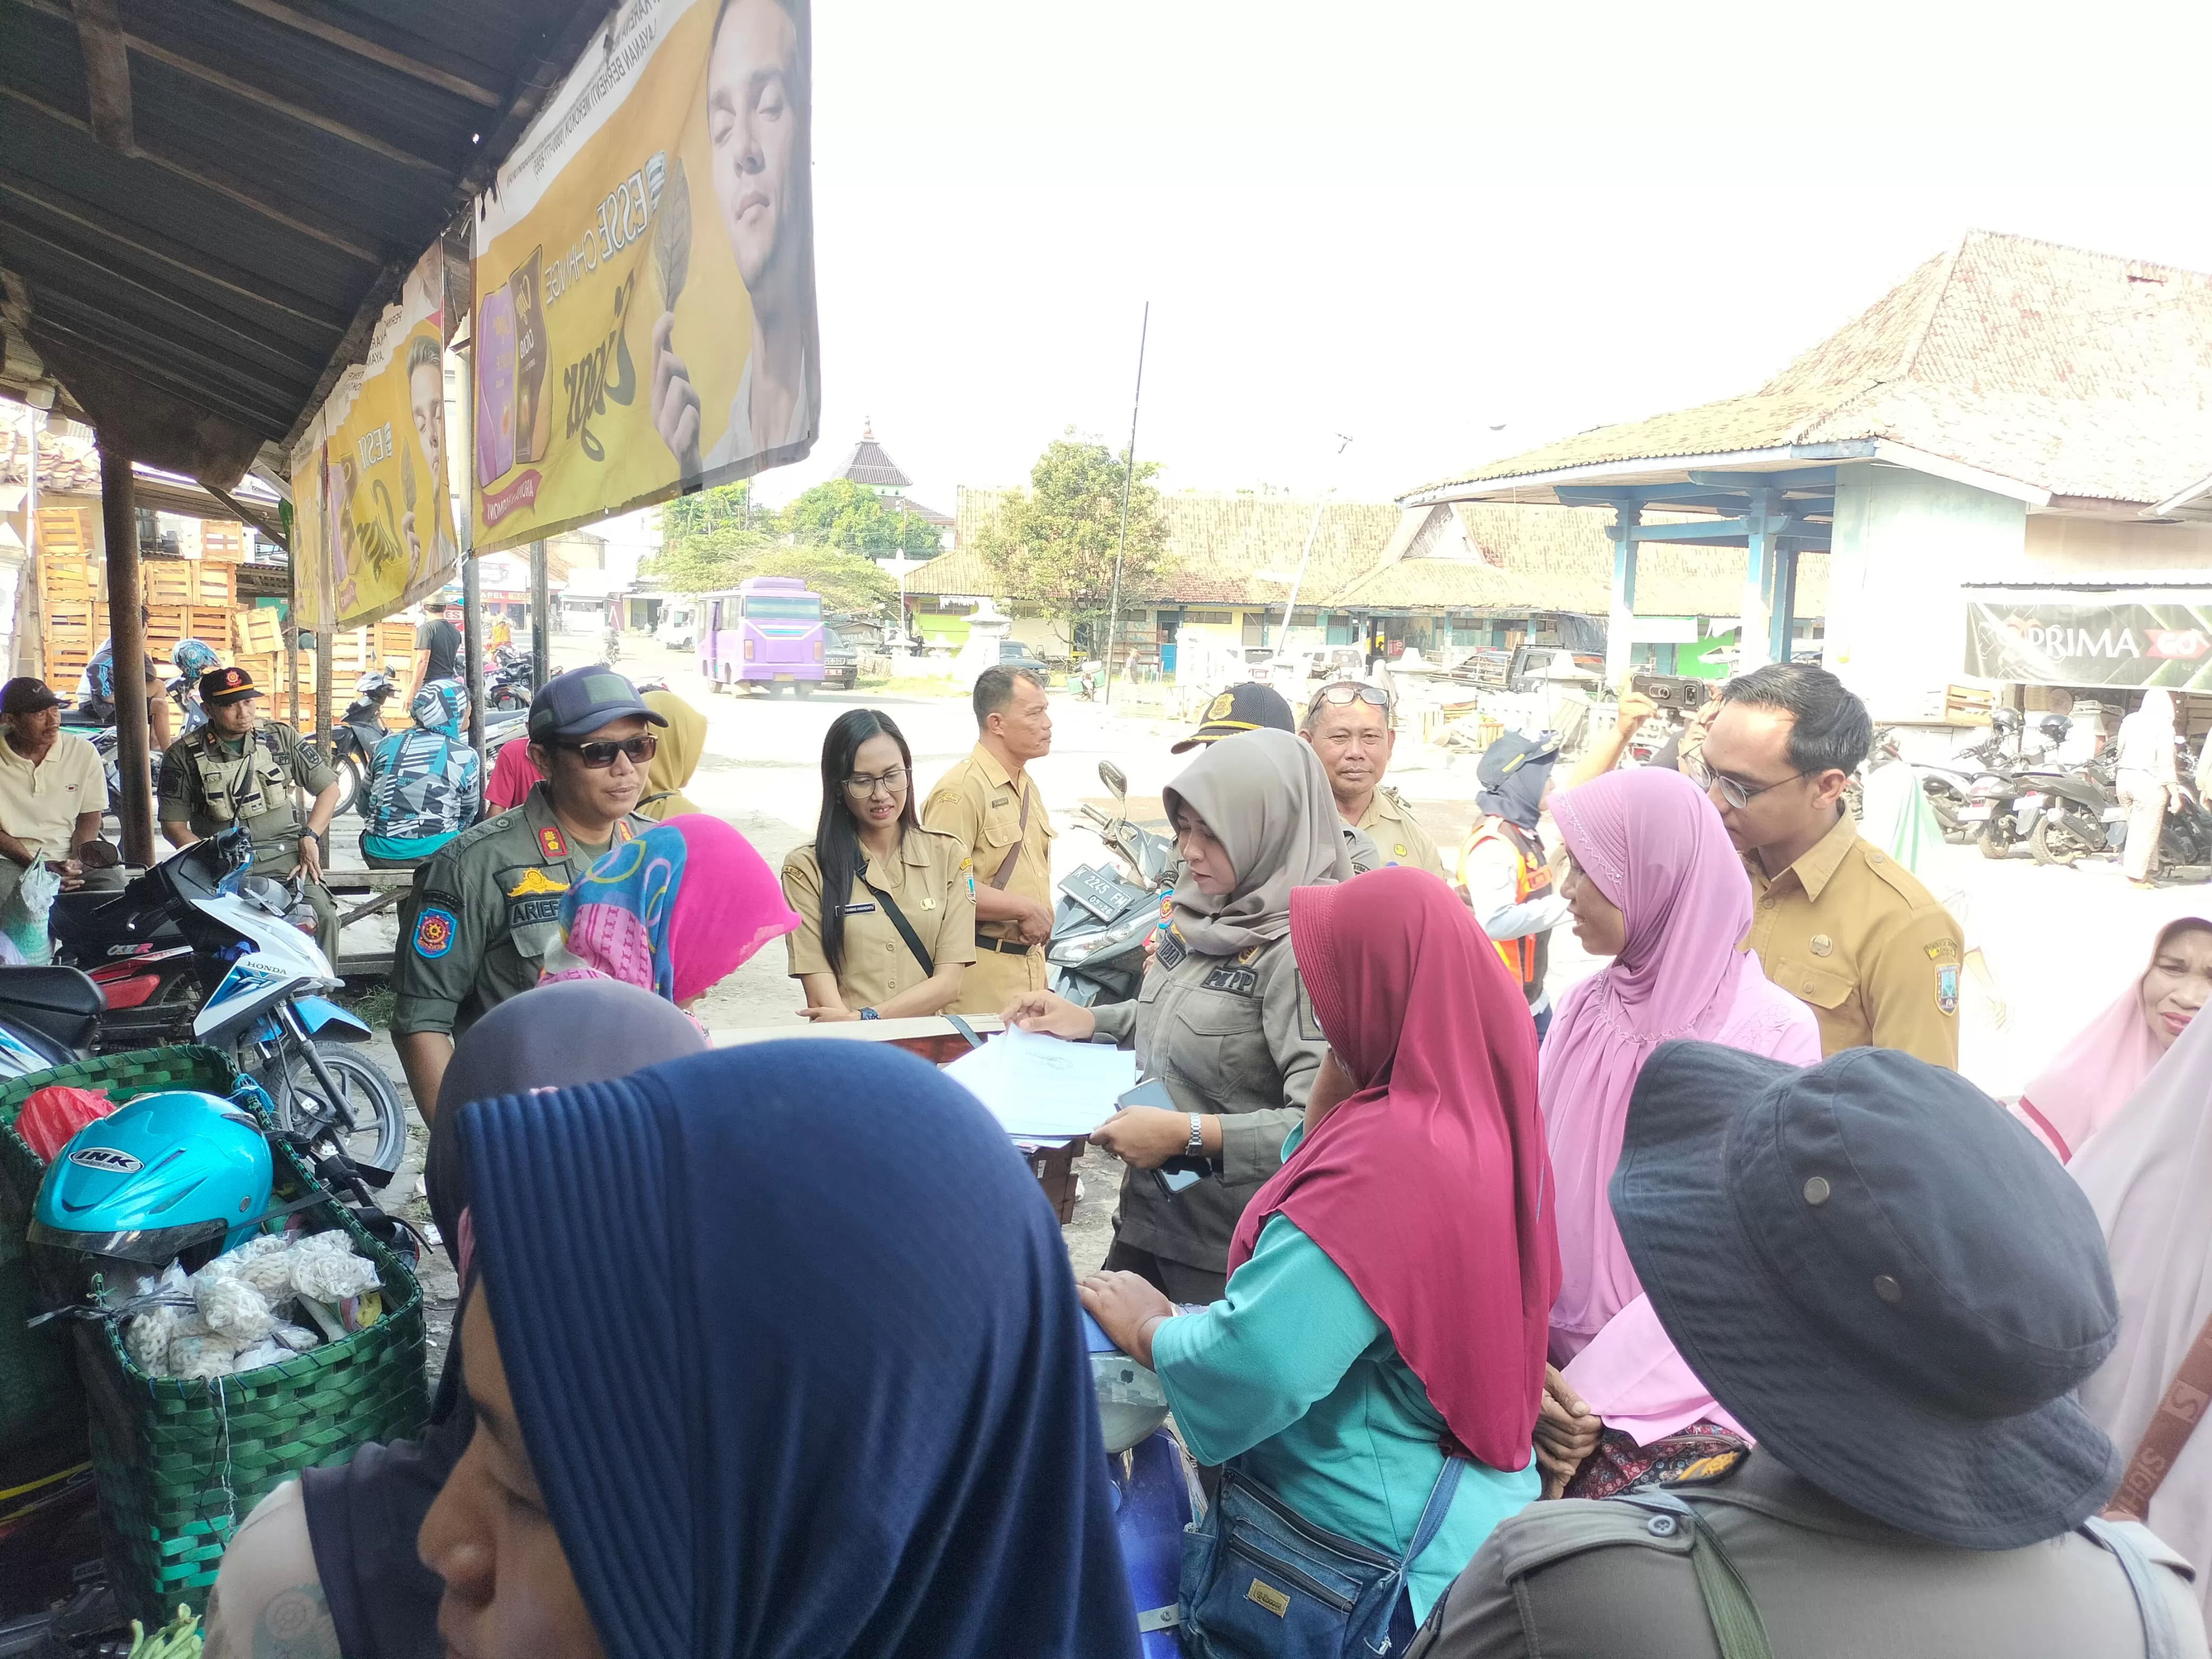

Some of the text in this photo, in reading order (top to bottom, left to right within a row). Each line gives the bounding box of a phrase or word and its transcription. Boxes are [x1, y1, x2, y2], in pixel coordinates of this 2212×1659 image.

[2028, 627, 2200, 659] PRIMA GO
[1075, 868, 1128, 908] K 2245 FM
[513, 900, 559, 923] ARIEF
[247, 960, 288, 975] HONDA
[76, 1151, 138, 1168] INK
